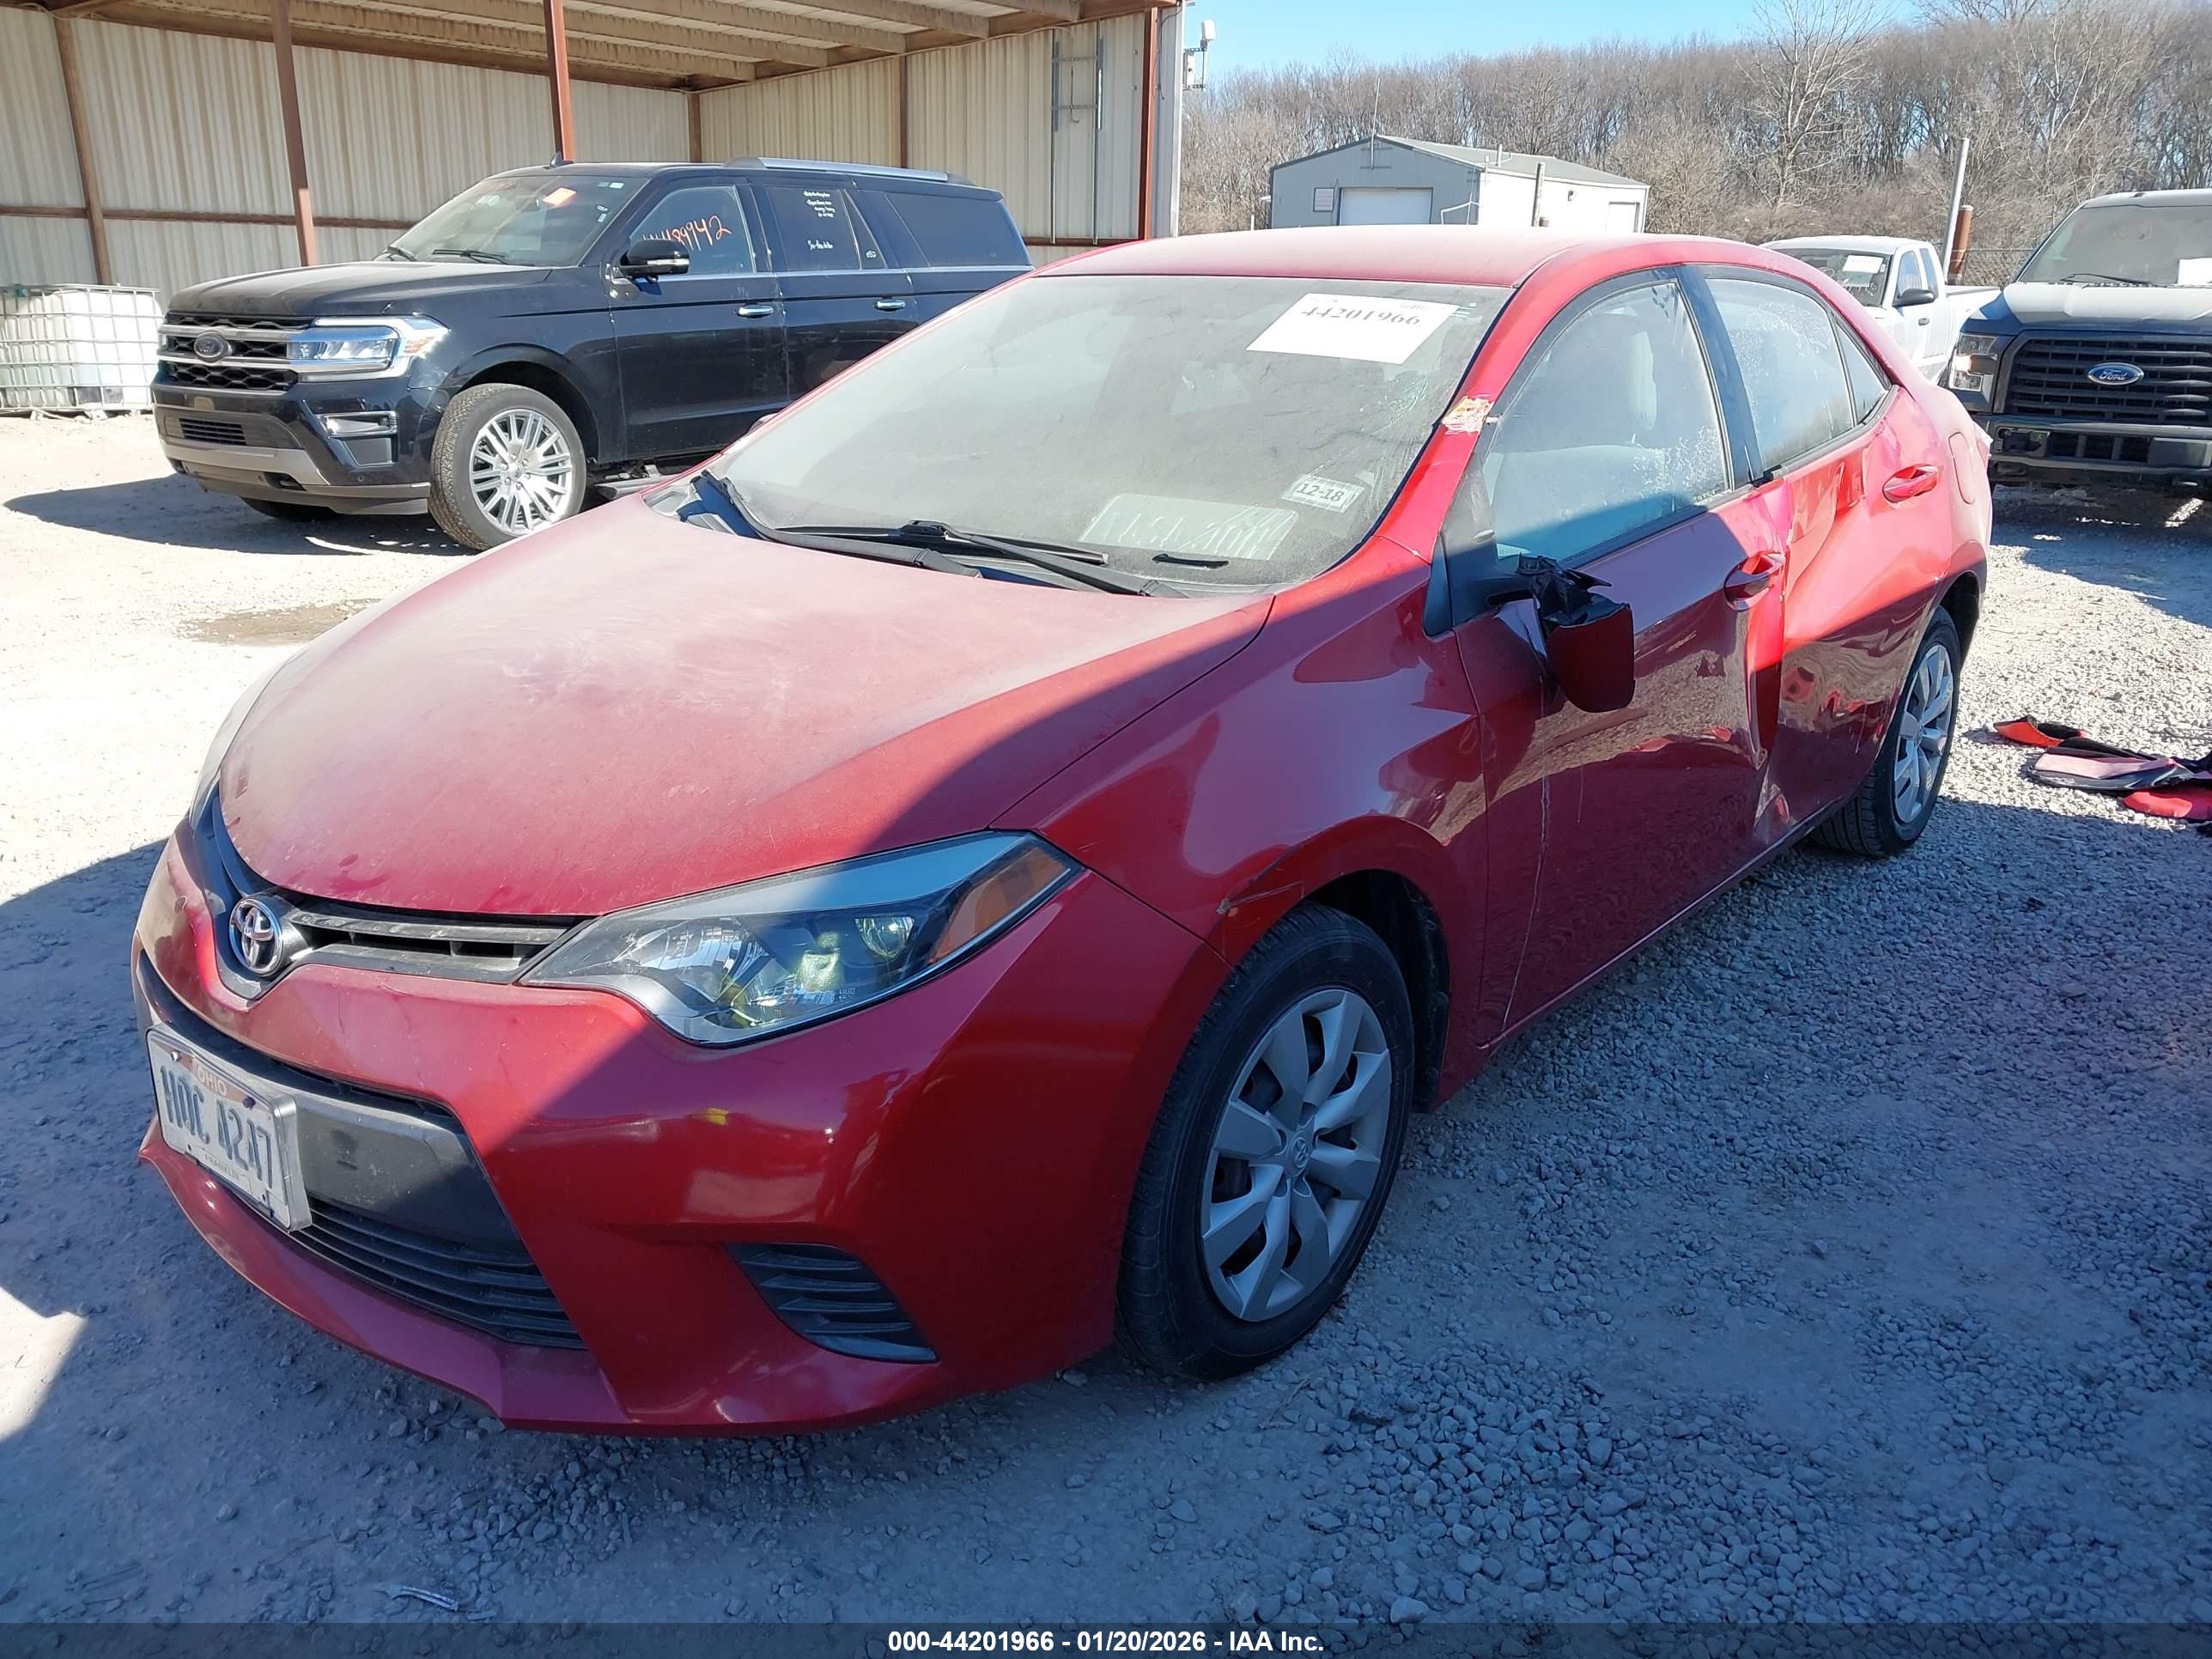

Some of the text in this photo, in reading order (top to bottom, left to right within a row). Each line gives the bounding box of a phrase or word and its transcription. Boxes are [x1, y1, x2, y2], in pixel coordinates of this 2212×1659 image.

[1301, 306, 1421, 325] 44201966
[2100, 368, 2129, 381] Ford
[1296, 483, 1346, 502] 12-18
[197, 1066, 228, 1097] OHIO
[216, 1098, 273, 1189] 4247
